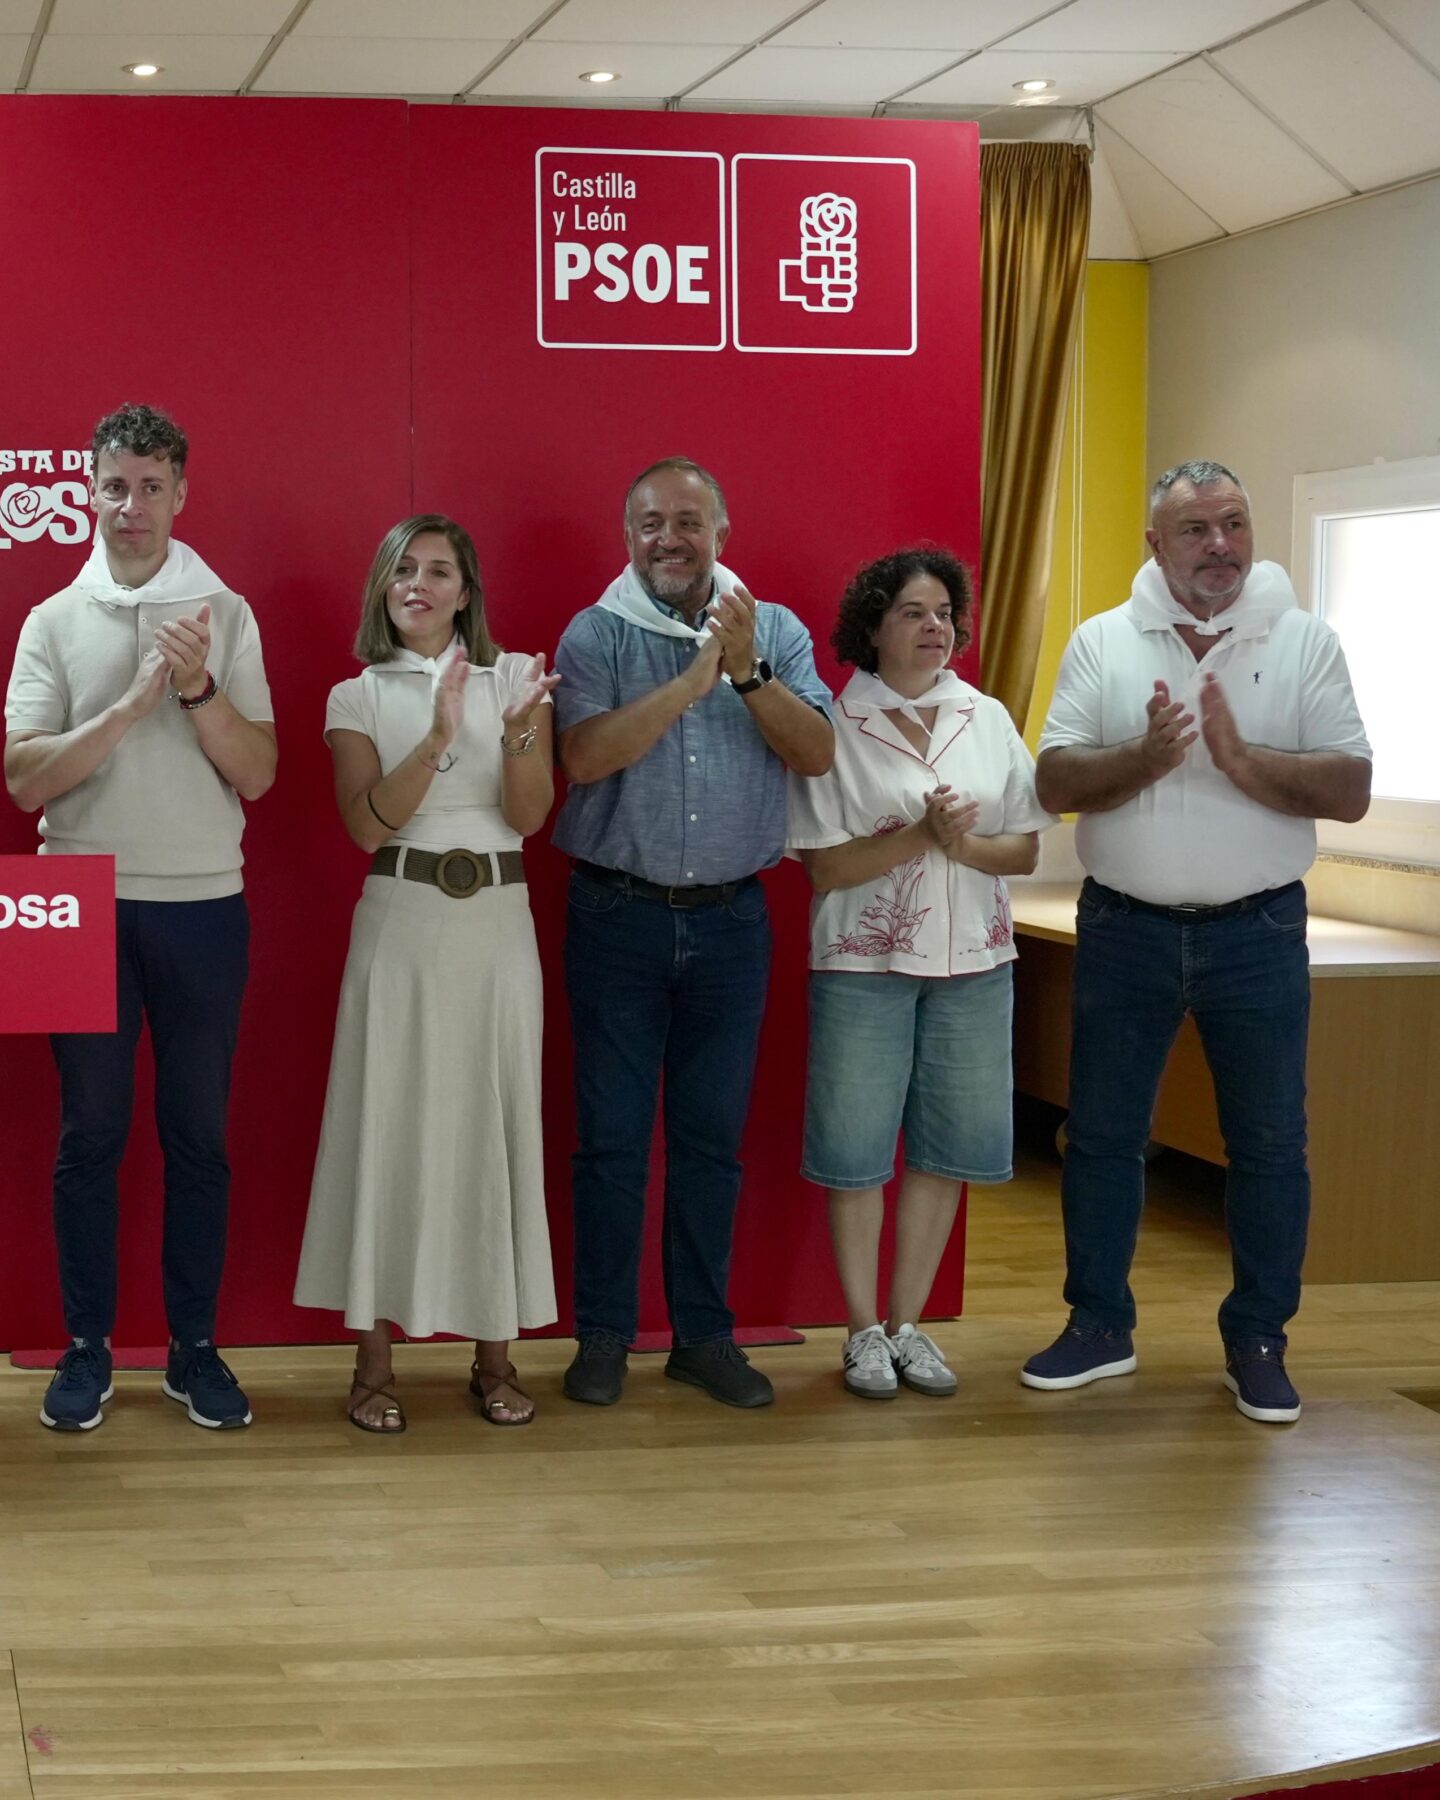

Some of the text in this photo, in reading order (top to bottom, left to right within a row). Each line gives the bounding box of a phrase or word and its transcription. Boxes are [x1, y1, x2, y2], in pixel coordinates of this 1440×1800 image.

[553, 170, 636, 199] Castilla
[553, 204, 627, 236] y León
[554, 241, 710, 304] PSOE
